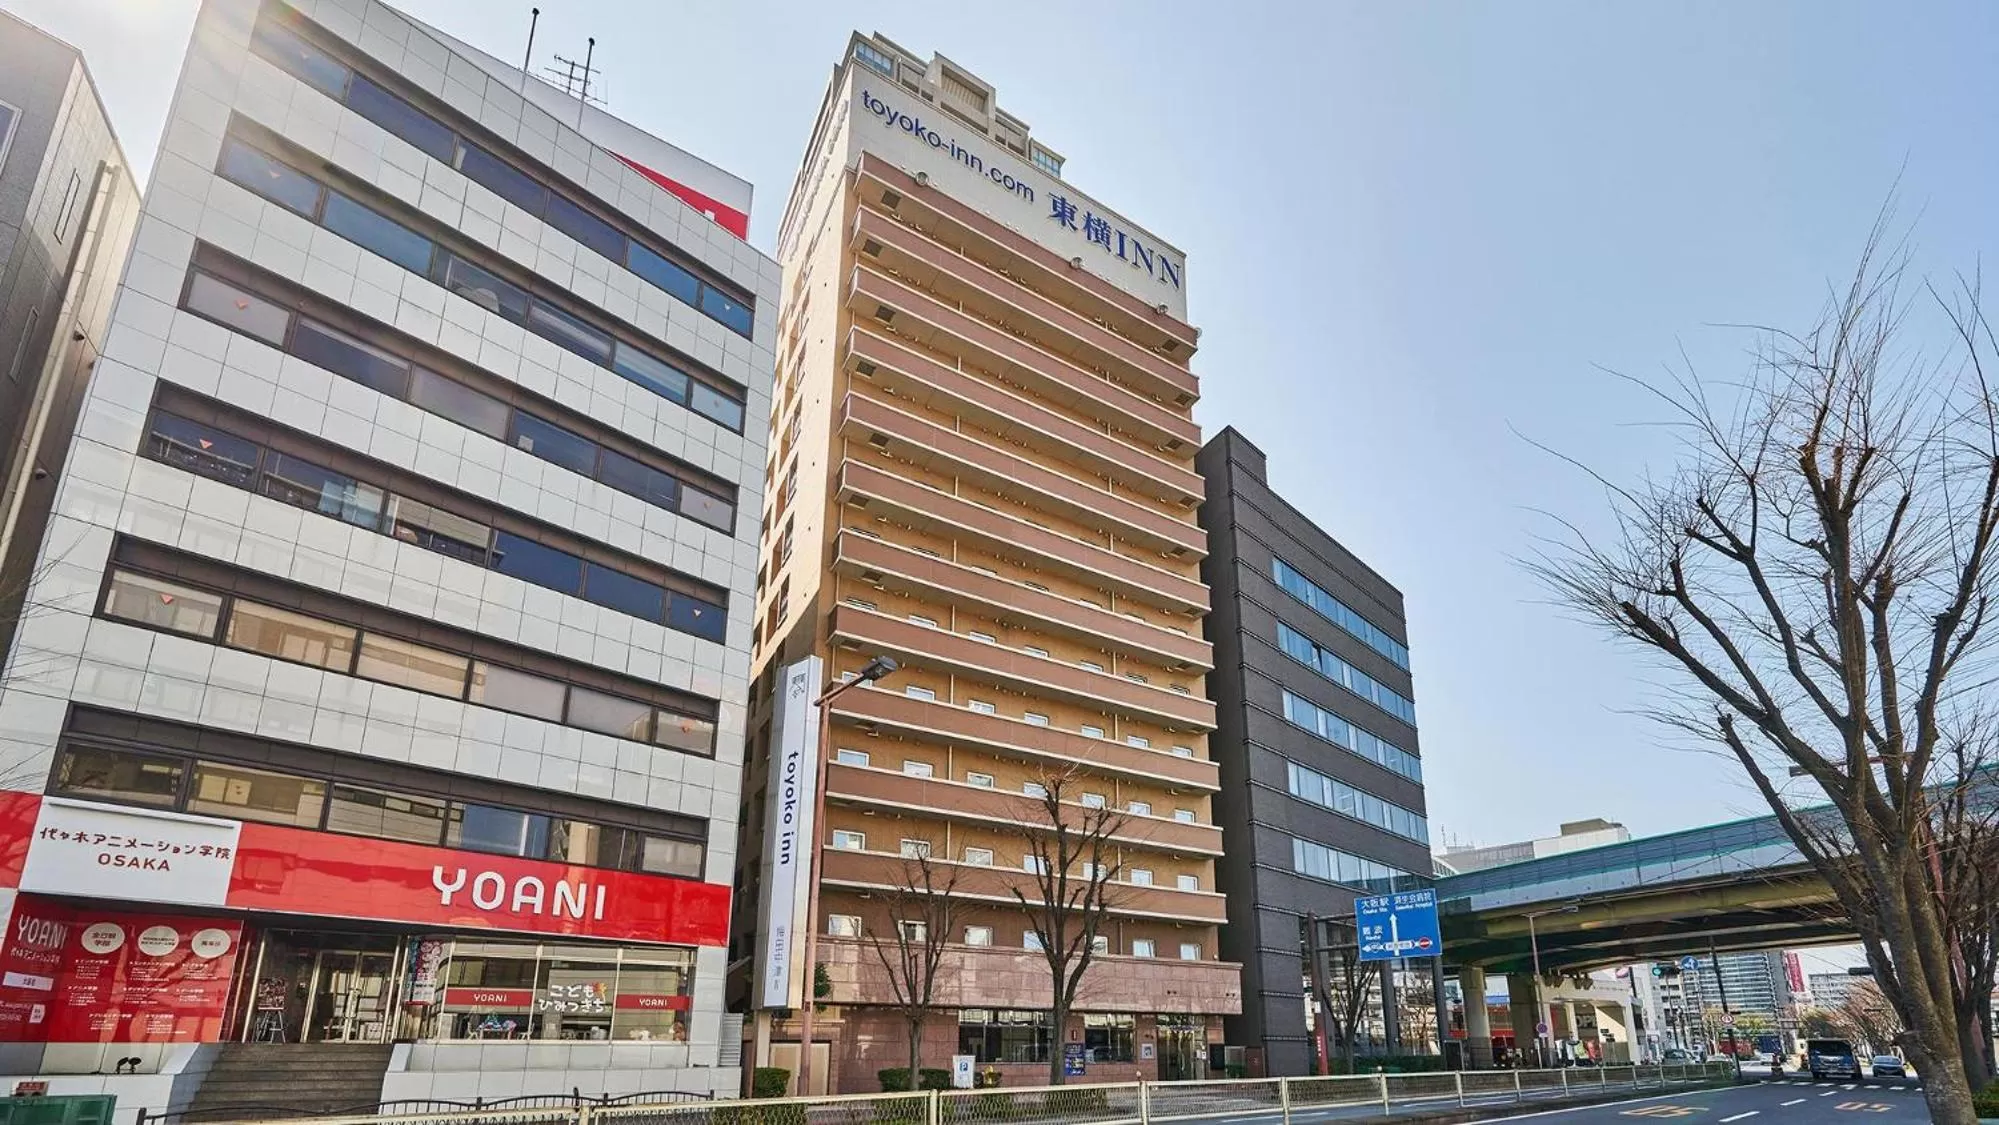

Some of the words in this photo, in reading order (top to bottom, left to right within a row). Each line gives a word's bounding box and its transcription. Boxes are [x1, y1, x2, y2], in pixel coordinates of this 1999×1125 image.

[862, 88, 1035, 203] toyoko-inn.com
[1048, 190, 1181, 291] 東横INN
[782, 750, 799, 825] toyoko
[40, 827, 232, 860] 代々木アニメーション学院
[780, 831, 796, 865] inn
[98, 853, 171, 872] OSAKA
[432, 865, 606, 921] YOANI
[1361, 897, 1389, 909] 大阪駅
[17, 913, 69, 949] YOANI
[473, 993, 508, 1003] YOANI
[550, 983, 595, 999] こども
[639, 998, 668, 1007] YOANI
